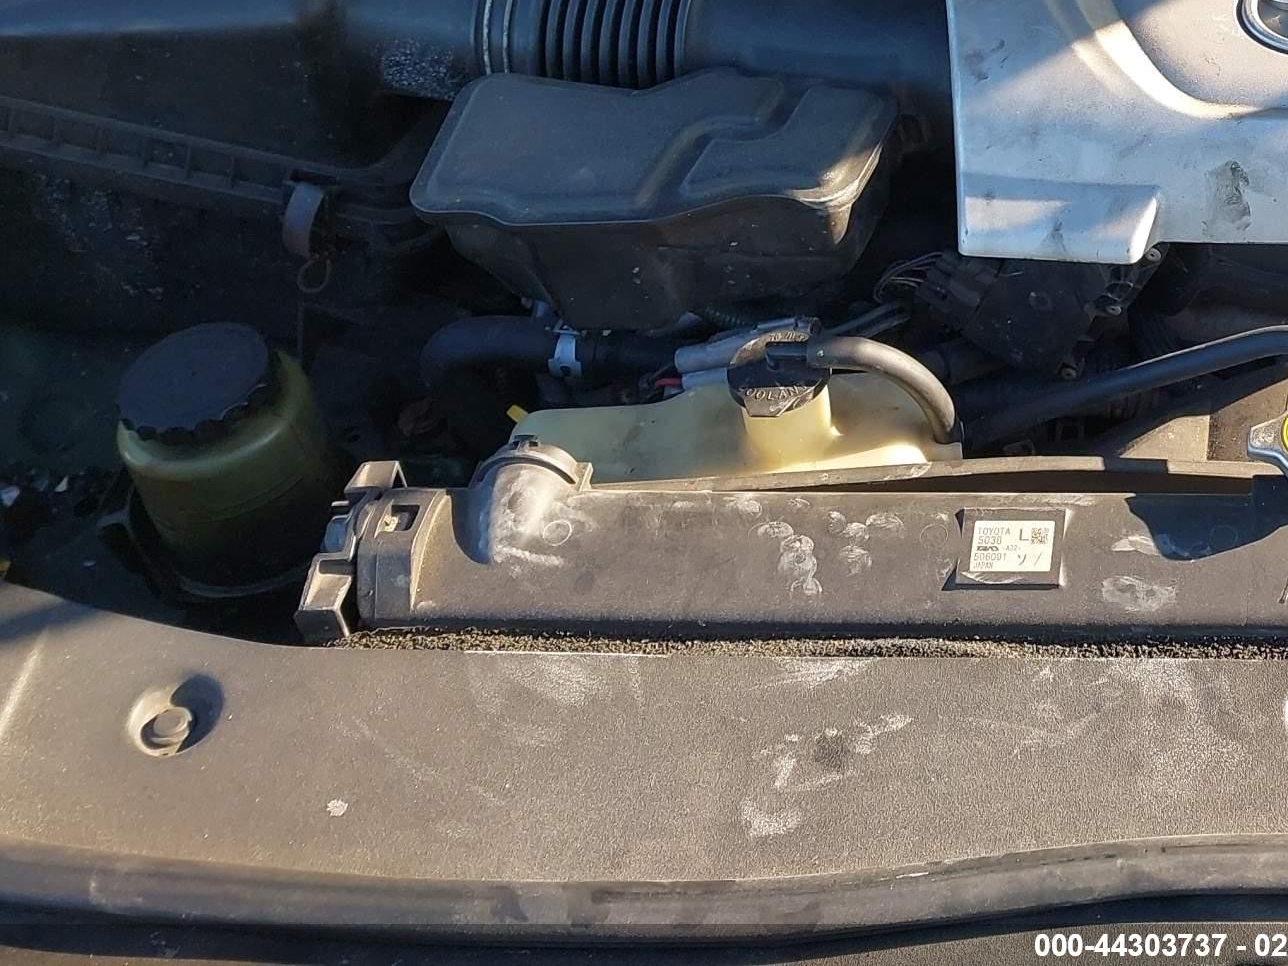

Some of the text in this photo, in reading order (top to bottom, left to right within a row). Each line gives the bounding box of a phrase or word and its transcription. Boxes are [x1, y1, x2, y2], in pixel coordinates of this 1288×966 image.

[978, 527, 1030, 542] TOYOTA L
[972, 561, 994, 570] JAPAN
